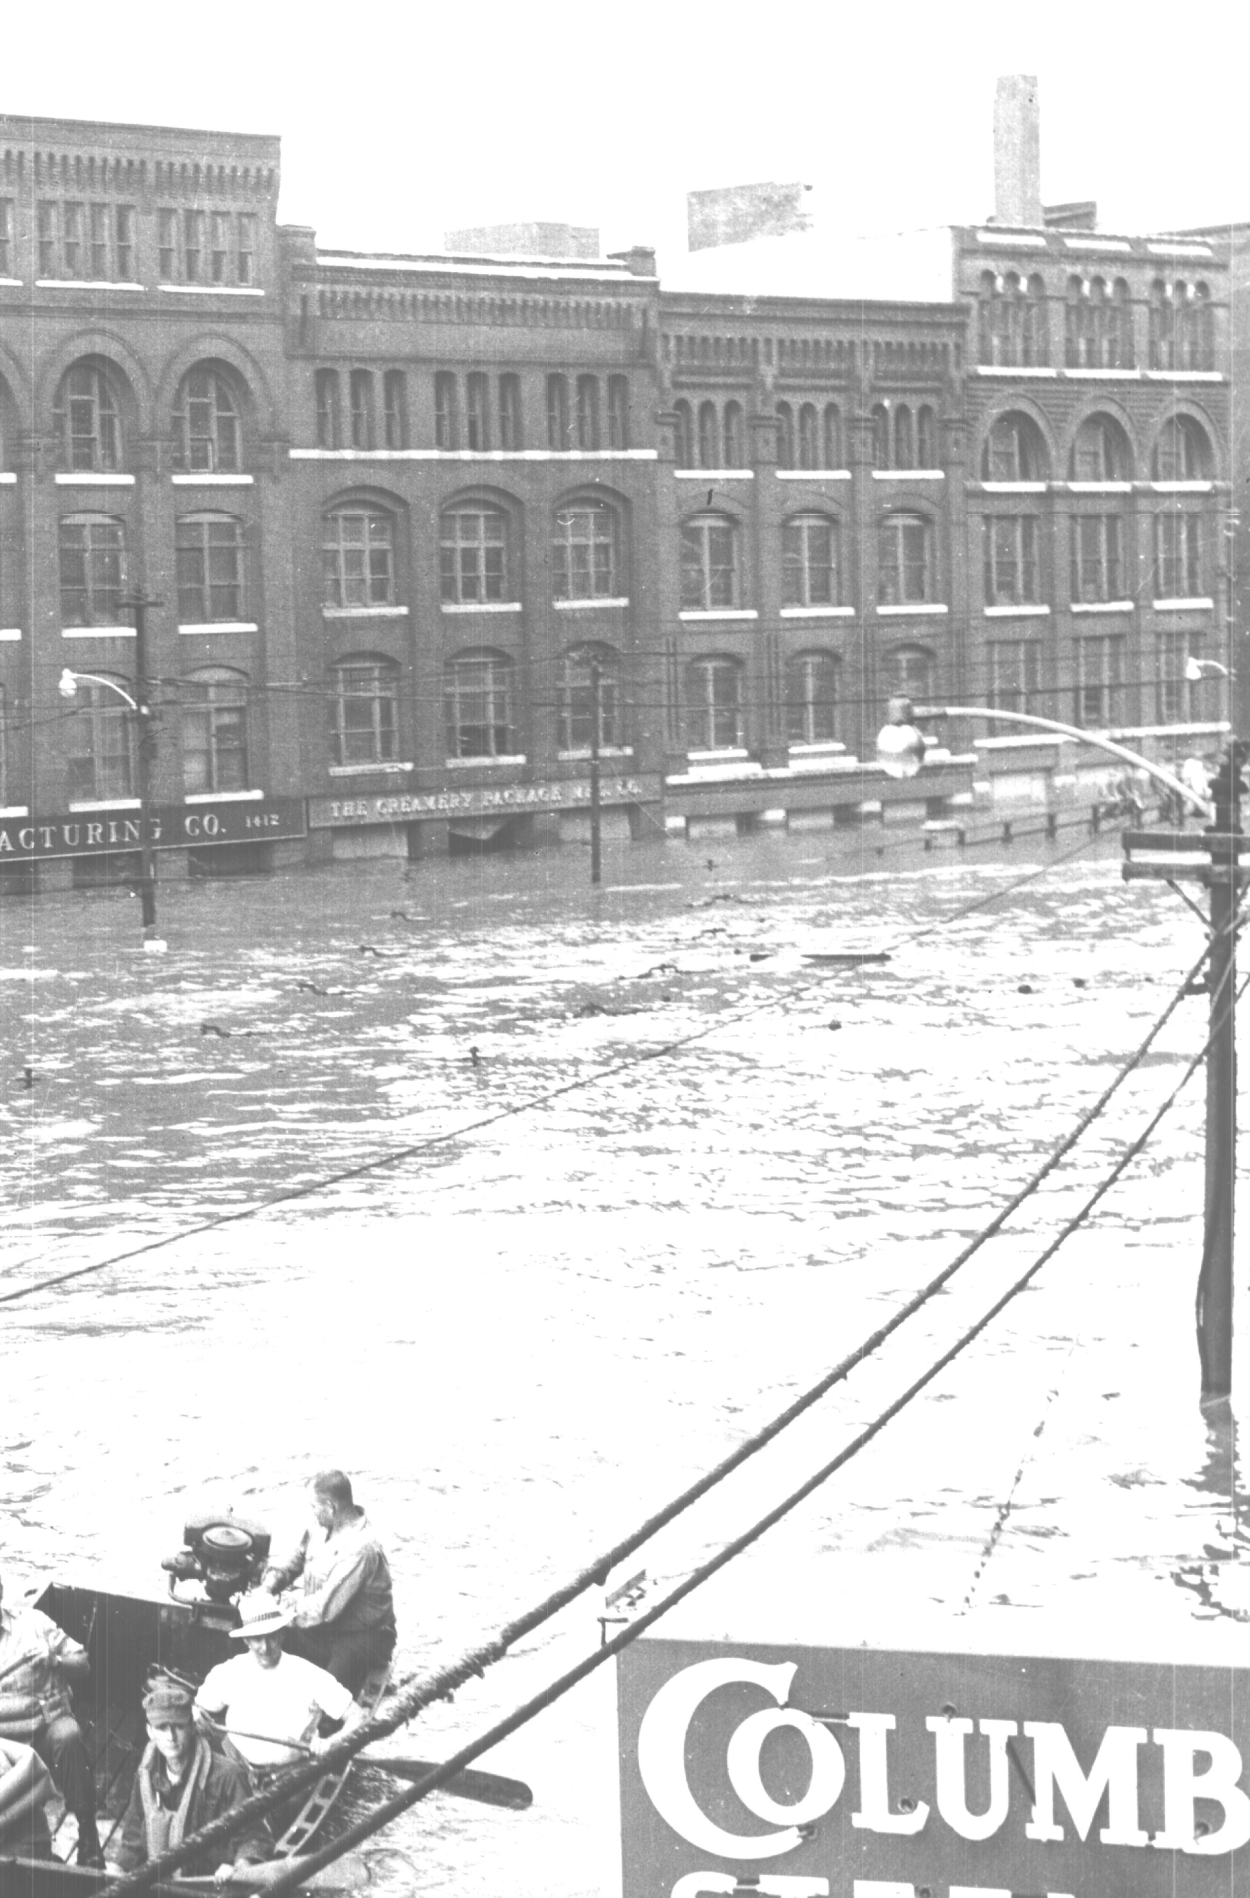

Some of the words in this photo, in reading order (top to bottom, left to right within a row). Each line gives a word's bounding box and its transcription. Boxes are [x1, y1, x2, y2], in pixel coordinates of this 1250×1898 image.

[330, 801, 367, 817] THE
[376, 793, 473, 814] CREAMERY
[483, 785, 562, 806] PACKAGE
[184, 814, 227, 836] CO.
